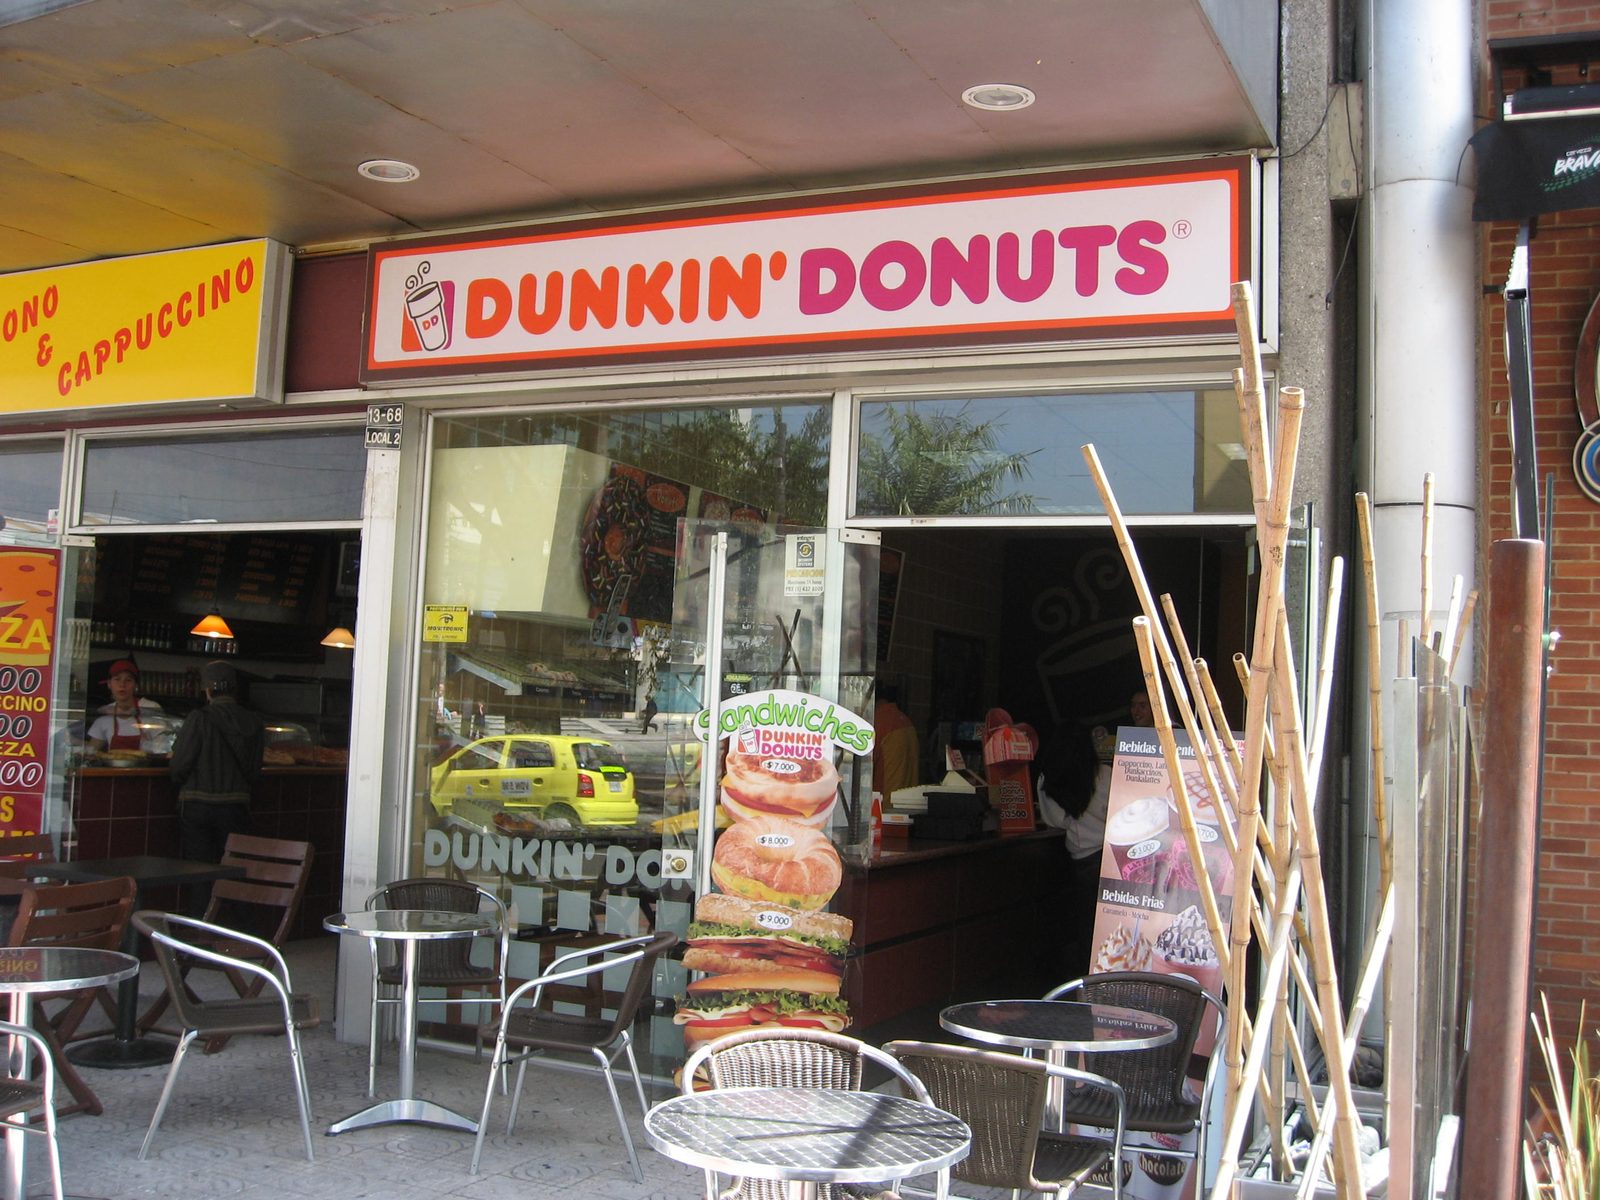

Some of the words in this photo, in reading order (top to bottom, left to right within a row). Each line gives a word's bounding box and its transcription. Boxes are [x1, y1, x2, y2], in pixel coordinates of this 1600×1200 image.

[465, 251, 787, 338] DUNKIN'
[799, 220, 1169, 315] DONUTS
[58, 257, 254, 396] CAPPUCCINO
[37, 333, 53, 367] &
[370, 408, 402, 422] 13-68
[366, 431, 392, 444] LOCAL
[394, 433, 400, 444] 2
[0, 696, 47, 712] CINO
[762, 730, 826, 746] DUNKIN'
[0, 742, 35, 757] ZA
[761, 743, 822, 759] DONUTS
[1119, 741, 1157, 754] Bebidas
[424, 829, 595, 881] DUNKIN'
[1102, 889, 1140, 907] Bebidas
[1141, 895, 1165, 910] Frias
